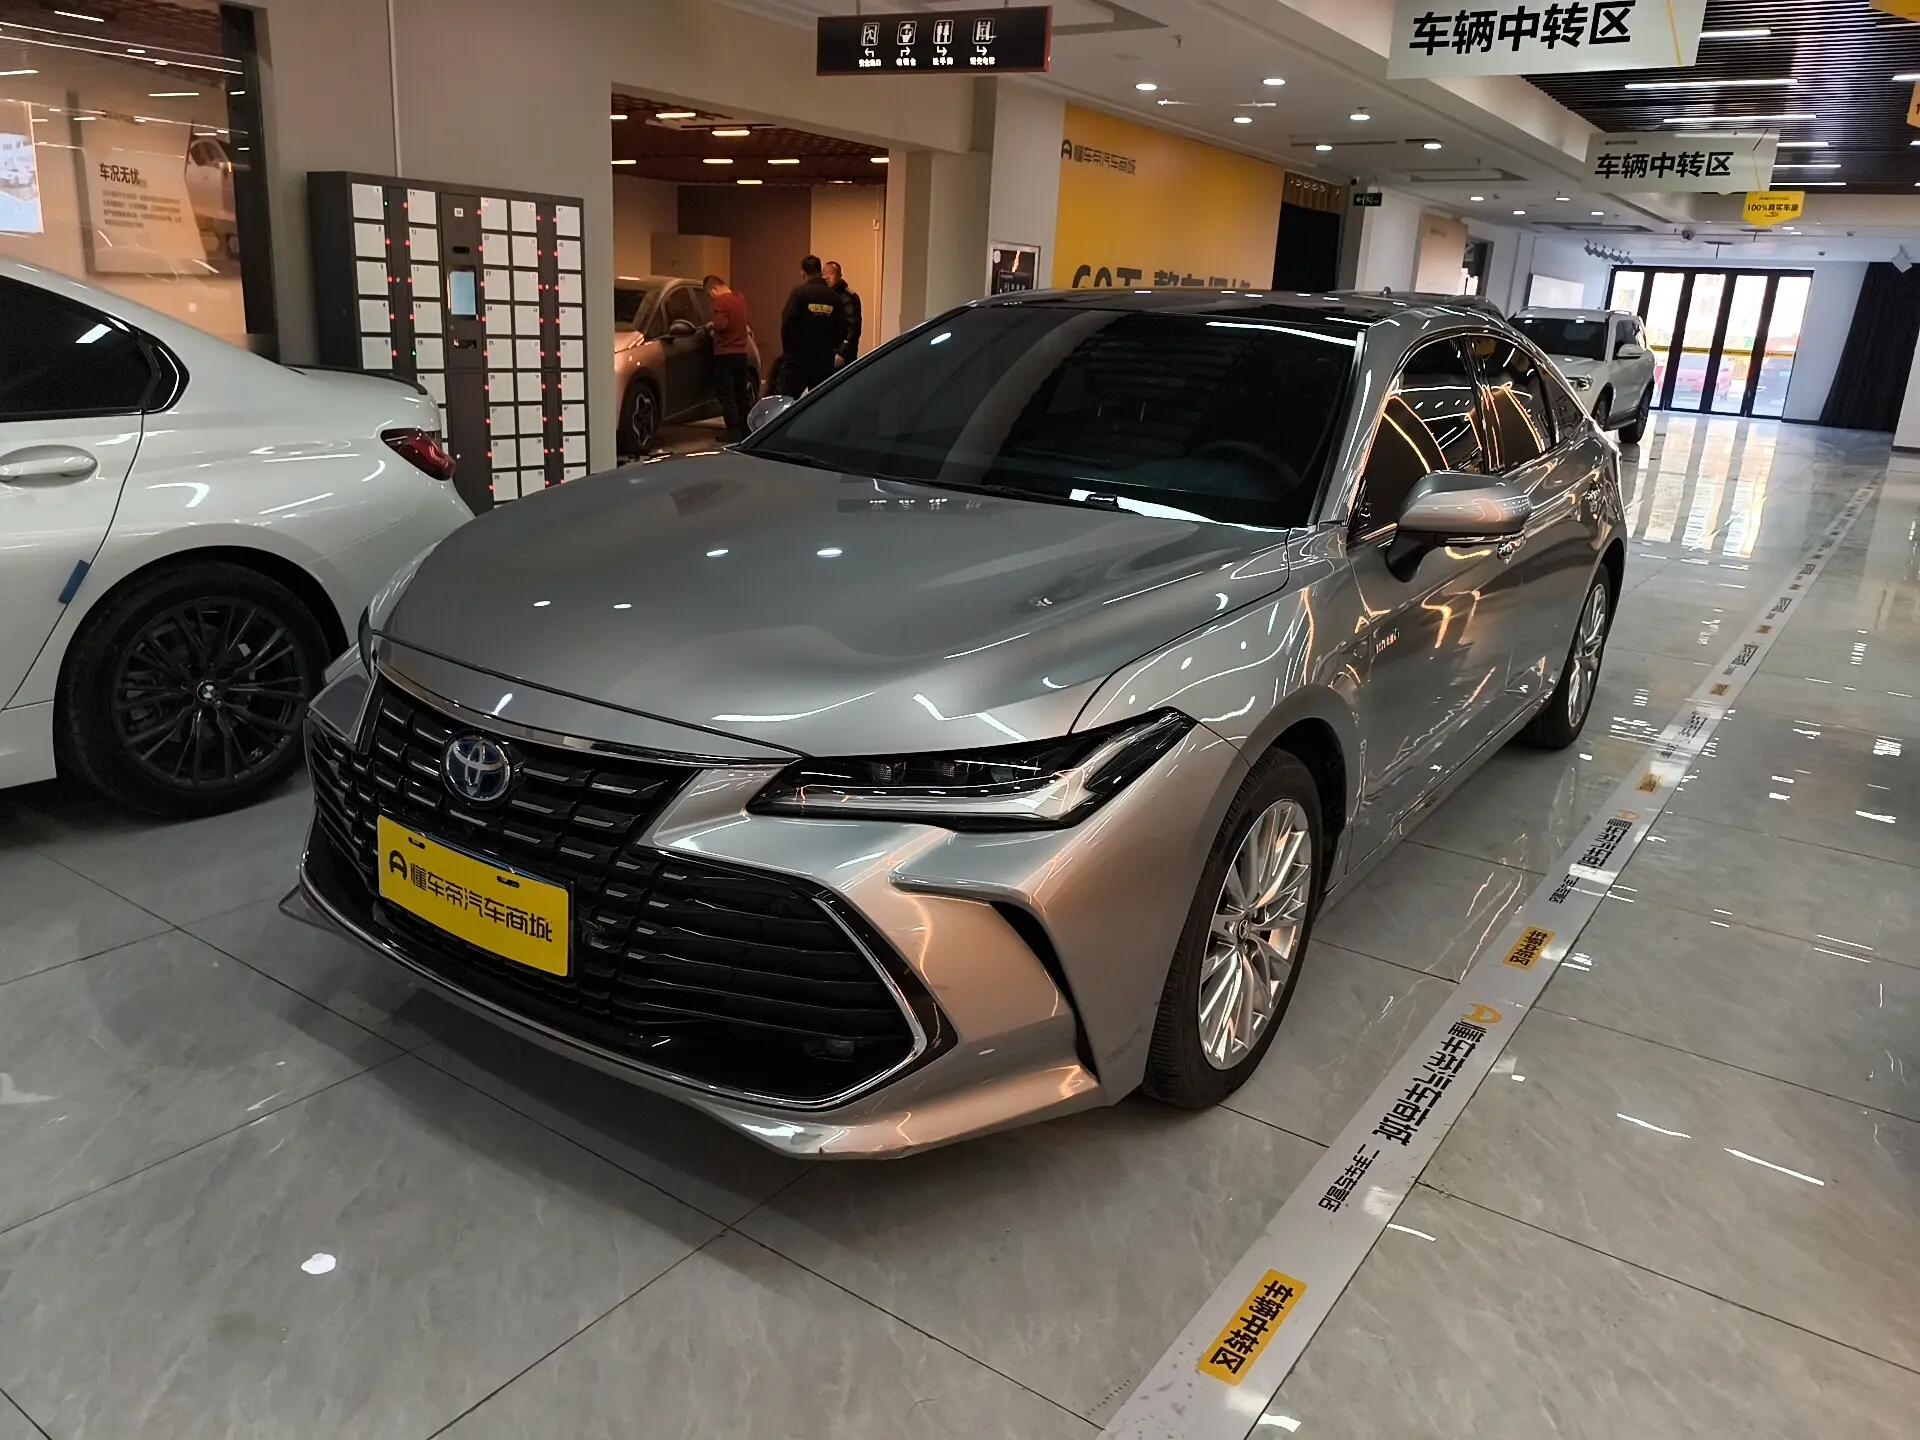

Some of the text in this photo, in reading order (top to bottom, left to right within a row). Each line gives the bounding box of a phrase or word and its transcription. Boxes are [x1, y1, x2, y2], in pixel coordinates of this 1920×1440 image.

[1409, 0, 1636, 56] 车辆中转区
[99, 162, 141, 186] 车况无忧
[1594, 151, 1734, 179] 车辆中转区
[1576, 818, 1633, 869] 懂车帝汽车商
[410, 862, 554, 943] 懂车帝汽车商城
[1317, 1021, 1487, 1213] 懂车帝汽车商城 二手车专营店
[1209, 1279, 1295, 1376] 车辆中转区
